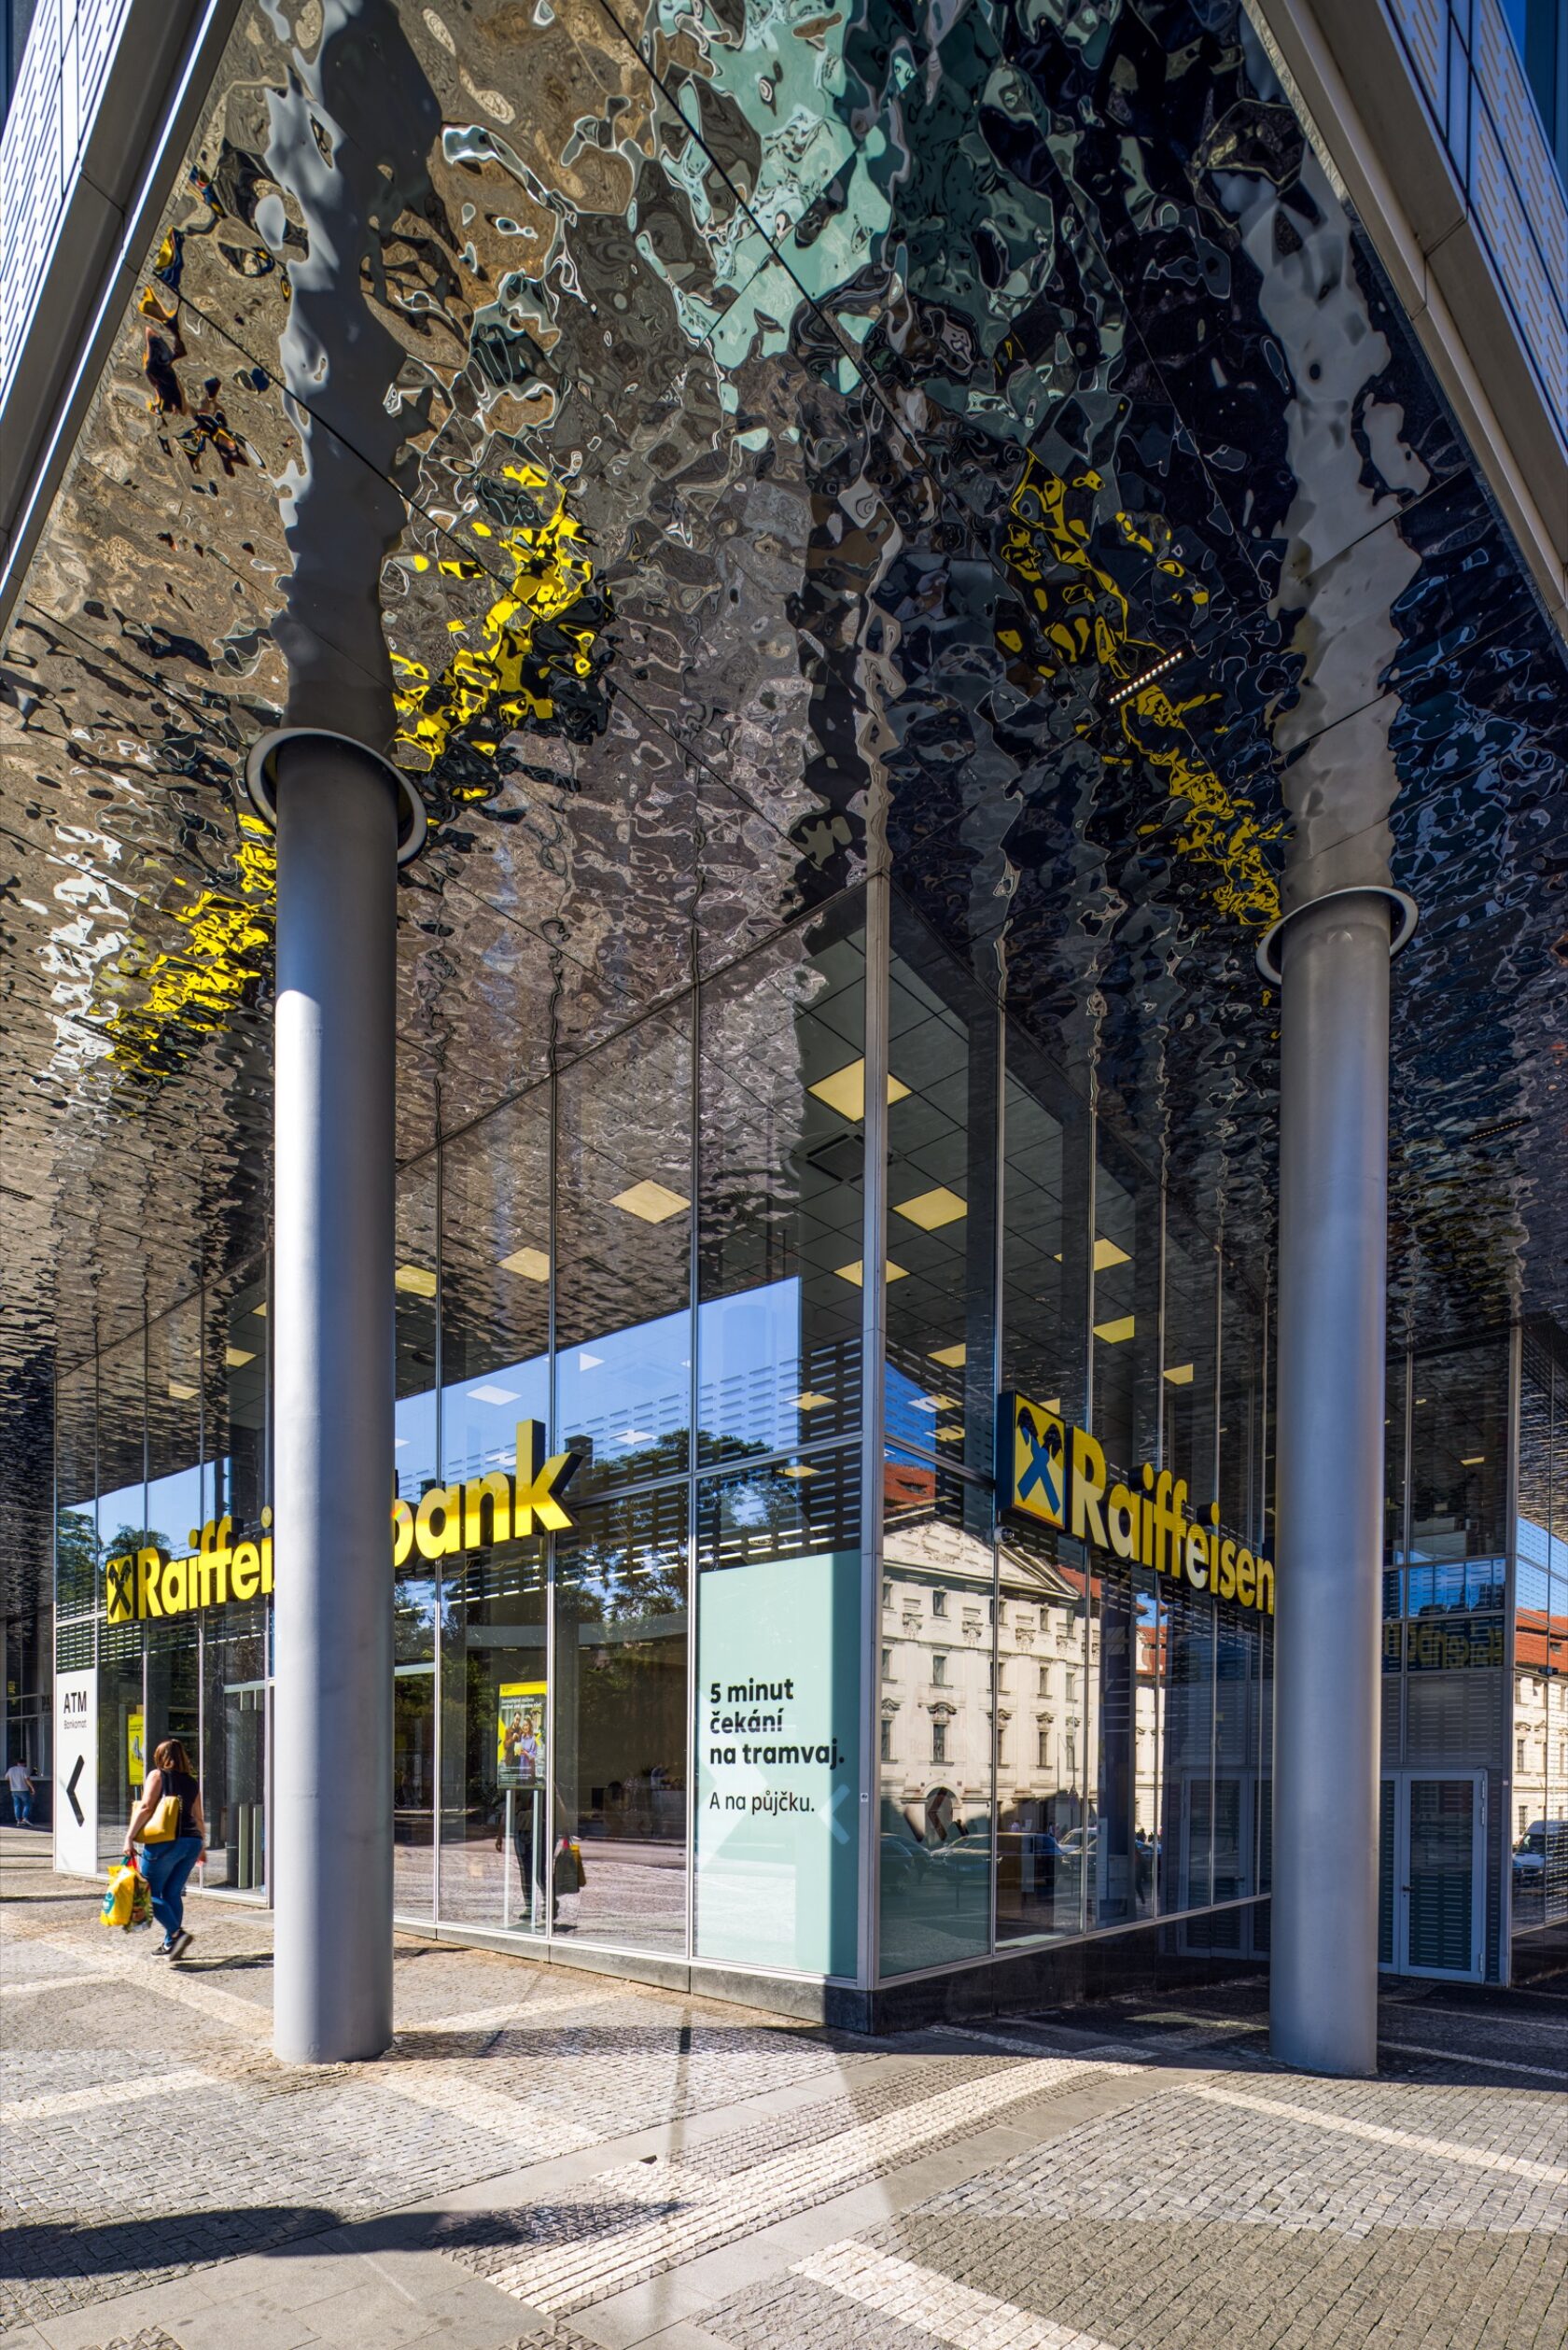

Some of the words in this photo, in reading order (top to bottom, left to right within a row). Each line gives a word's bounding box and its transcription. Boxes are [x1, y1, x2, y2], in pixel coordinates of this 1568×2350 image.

[1071, 1425, 1275, 1616] Raiffeisen
[137, 1505, 274, 1620] Raiffei
[63, 1690, 87, 1714] ATM
[710, 1683, 721, 1703] 5
[727, 1677, 794, 1702] minut
[709, 1707, 784, 1734] čekání
[709, 1746, 735, 1765] na
[742, 1738, 845, 1770] tramvaj.
[709, 1791, 721, 1810] A
[725, 1795, 746, 1811] na
[751, 1790, 815, 1816] půjčku.
